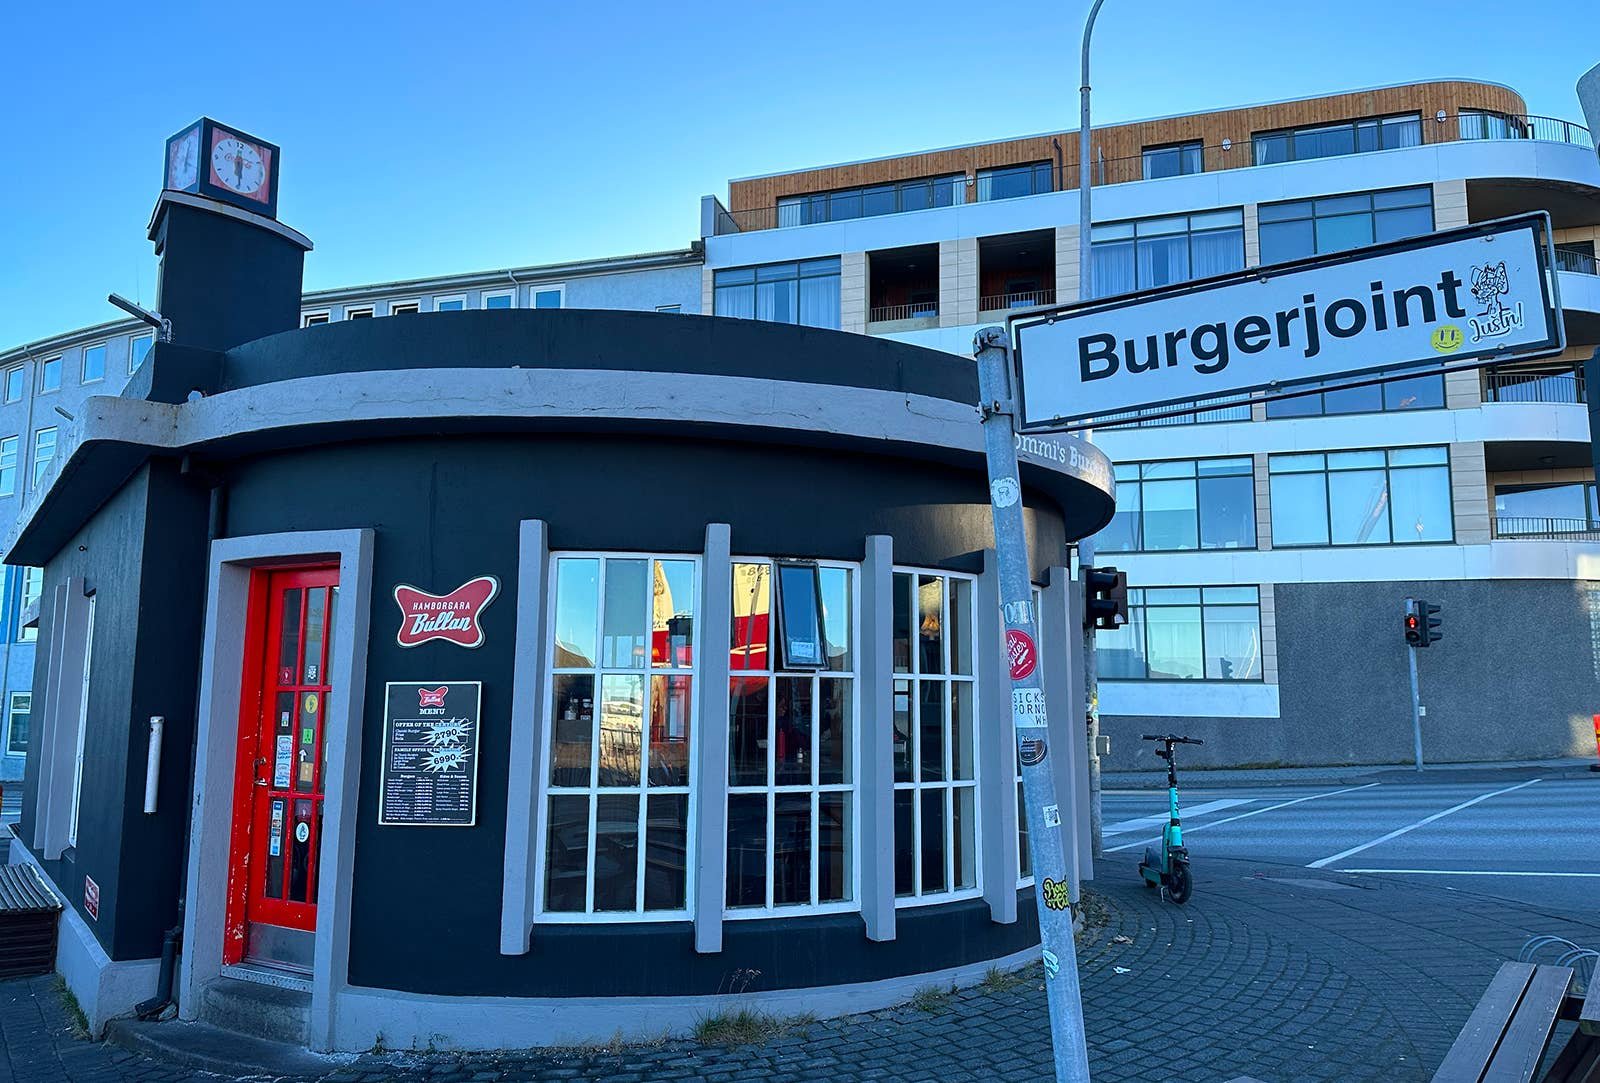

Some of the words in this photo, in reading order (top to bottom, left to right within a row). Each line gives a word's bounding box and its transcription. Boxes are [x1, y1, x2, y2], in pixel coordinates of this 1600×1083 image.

[1078, 270, 1466, 382] Burgerjoint
[1015, 433, 1066, 463] ommi's
[413, 602, 471, 610] HAMBORGARA
[408, 611, 472, 635] Búllan
